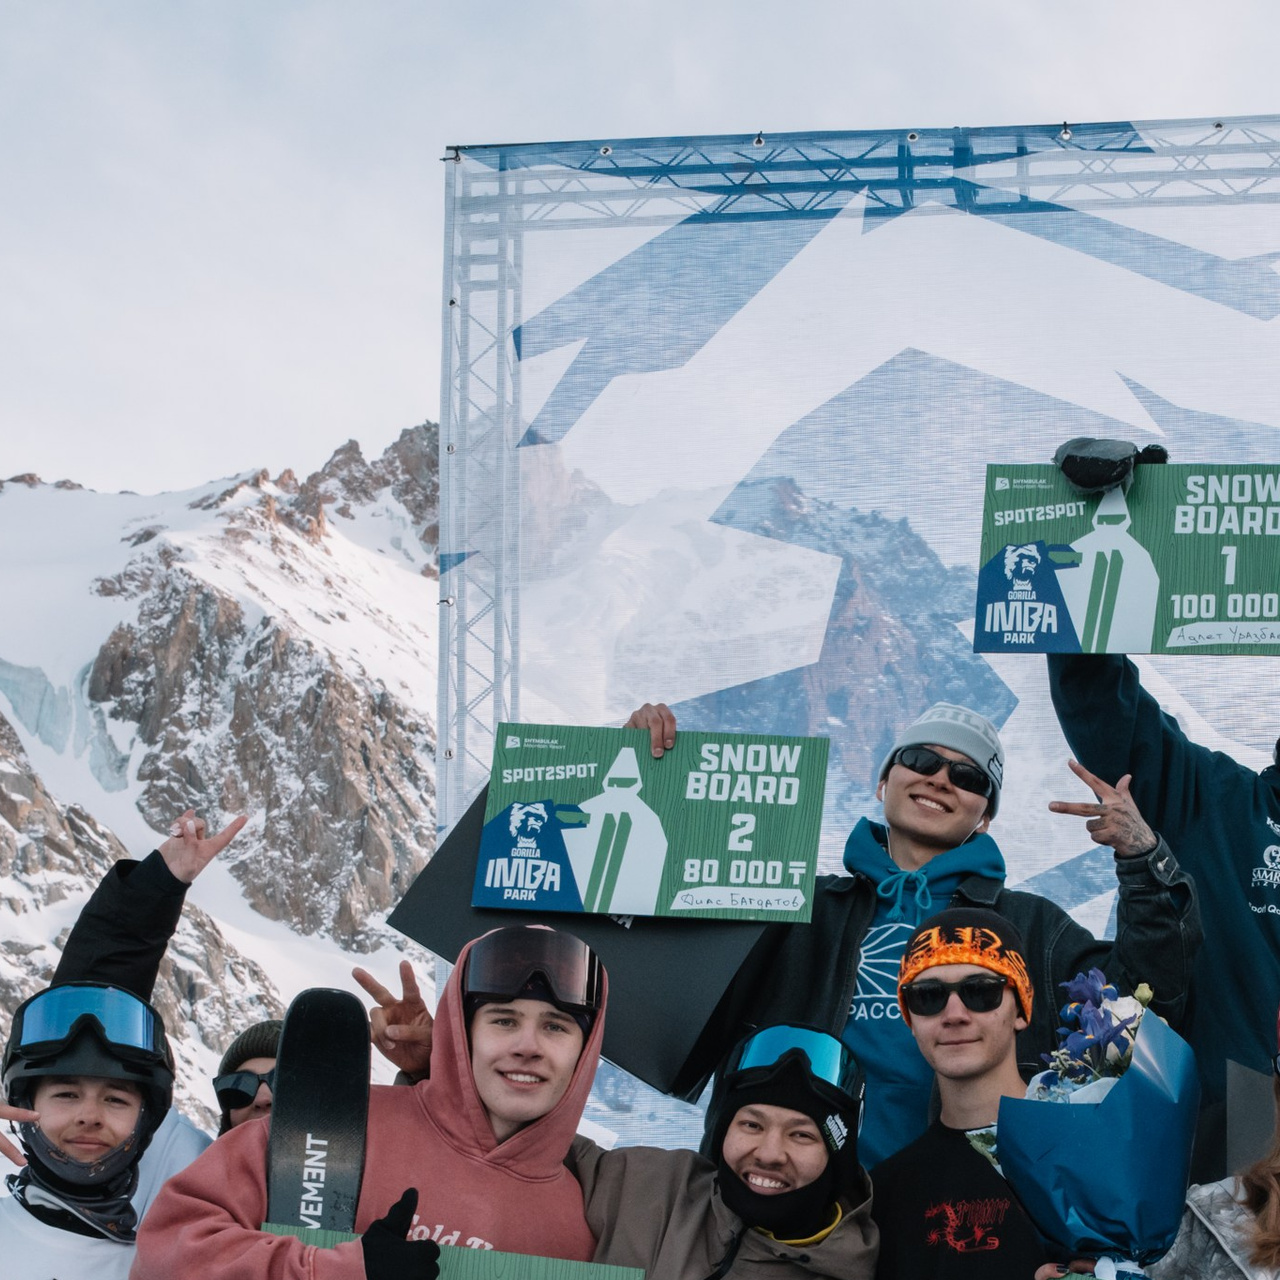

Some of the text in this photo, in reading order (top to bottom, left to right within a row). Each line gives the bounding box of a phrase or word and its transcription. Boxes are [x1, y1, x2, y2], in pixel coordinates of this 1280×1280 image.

[994, 501, 1087, 526] SPOT2SPOT
[1221, 546, 1236, 585] 1
[1007, 591, 1037, 600] GORILLA
[1171, 594, 1216, 619] 100
[984, 601, 1058, 633] IMBA
[1003, 633, 1036, 644] PARK
[699, 743, 802, 773] SNOW
[502, 763, 598, 783] SPOT2SPOT
[685, 772, 801, 805] BOARD
[728, 813, 756, 852] 2
[511, 848, 541, 858] GORILLA
[485, 859, 561, 892] IMBA
[683, 859, 719, 883] 80
[504, 889, 536, 901] PARK
[825, 1114, 846, 1150] GORILLA
[407, 1214, 461, 1246] old
